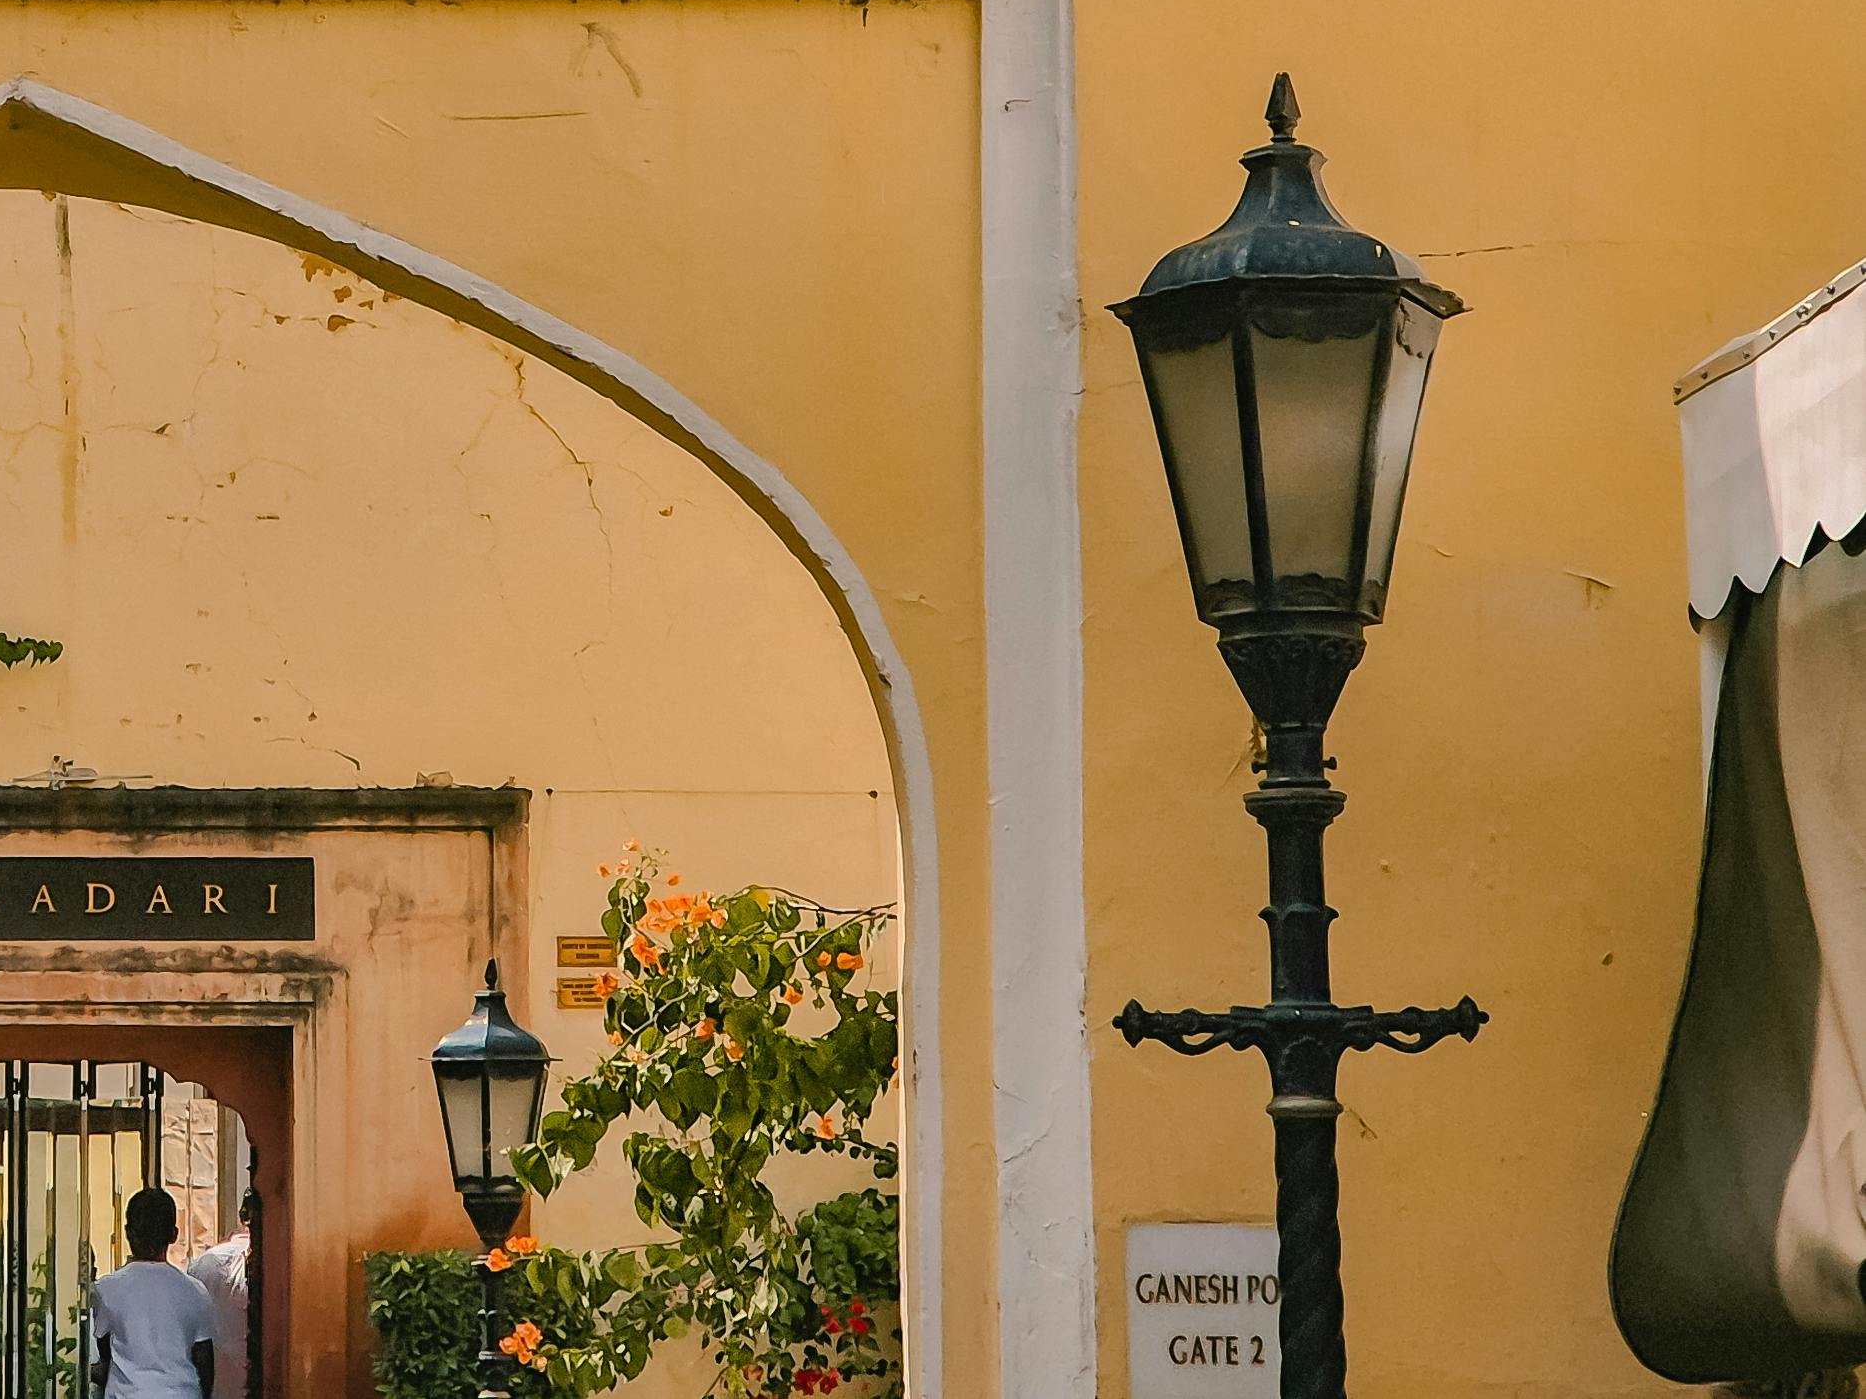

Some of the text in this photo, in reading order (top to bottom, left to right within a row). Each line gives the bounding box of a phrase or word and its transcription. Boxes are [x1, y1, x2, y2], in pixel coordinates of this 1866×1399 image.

[1135, 1273, 1280, 1305] GANESH PO
[1168, 1335, 1266, 1366] GATE 2
